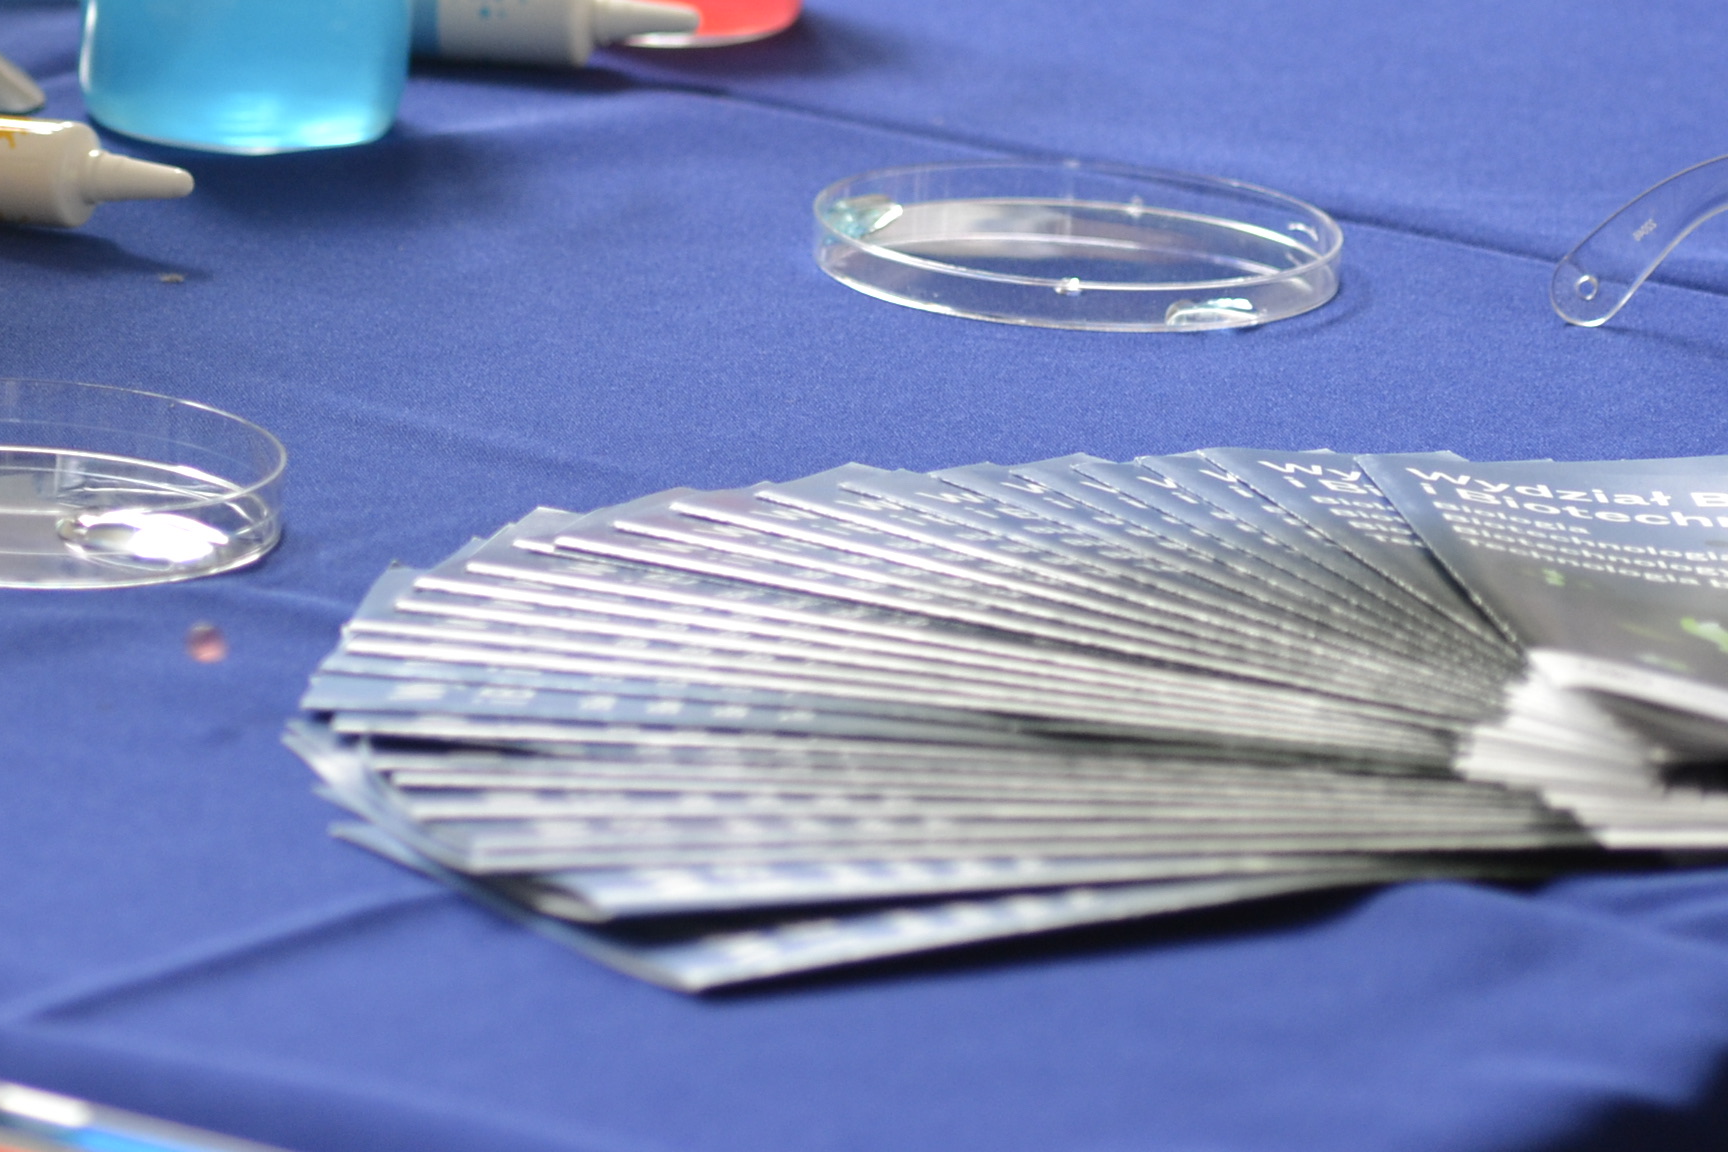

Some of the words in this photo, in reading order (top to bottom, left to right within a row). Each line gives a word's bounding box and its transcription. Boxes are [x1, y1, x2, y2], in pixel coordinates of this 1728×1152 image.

[1405, 466, 1672, 507] Wydział
[1420, 481, 1438, 496] i
[1432, 500, 1592, 535] Biologia
